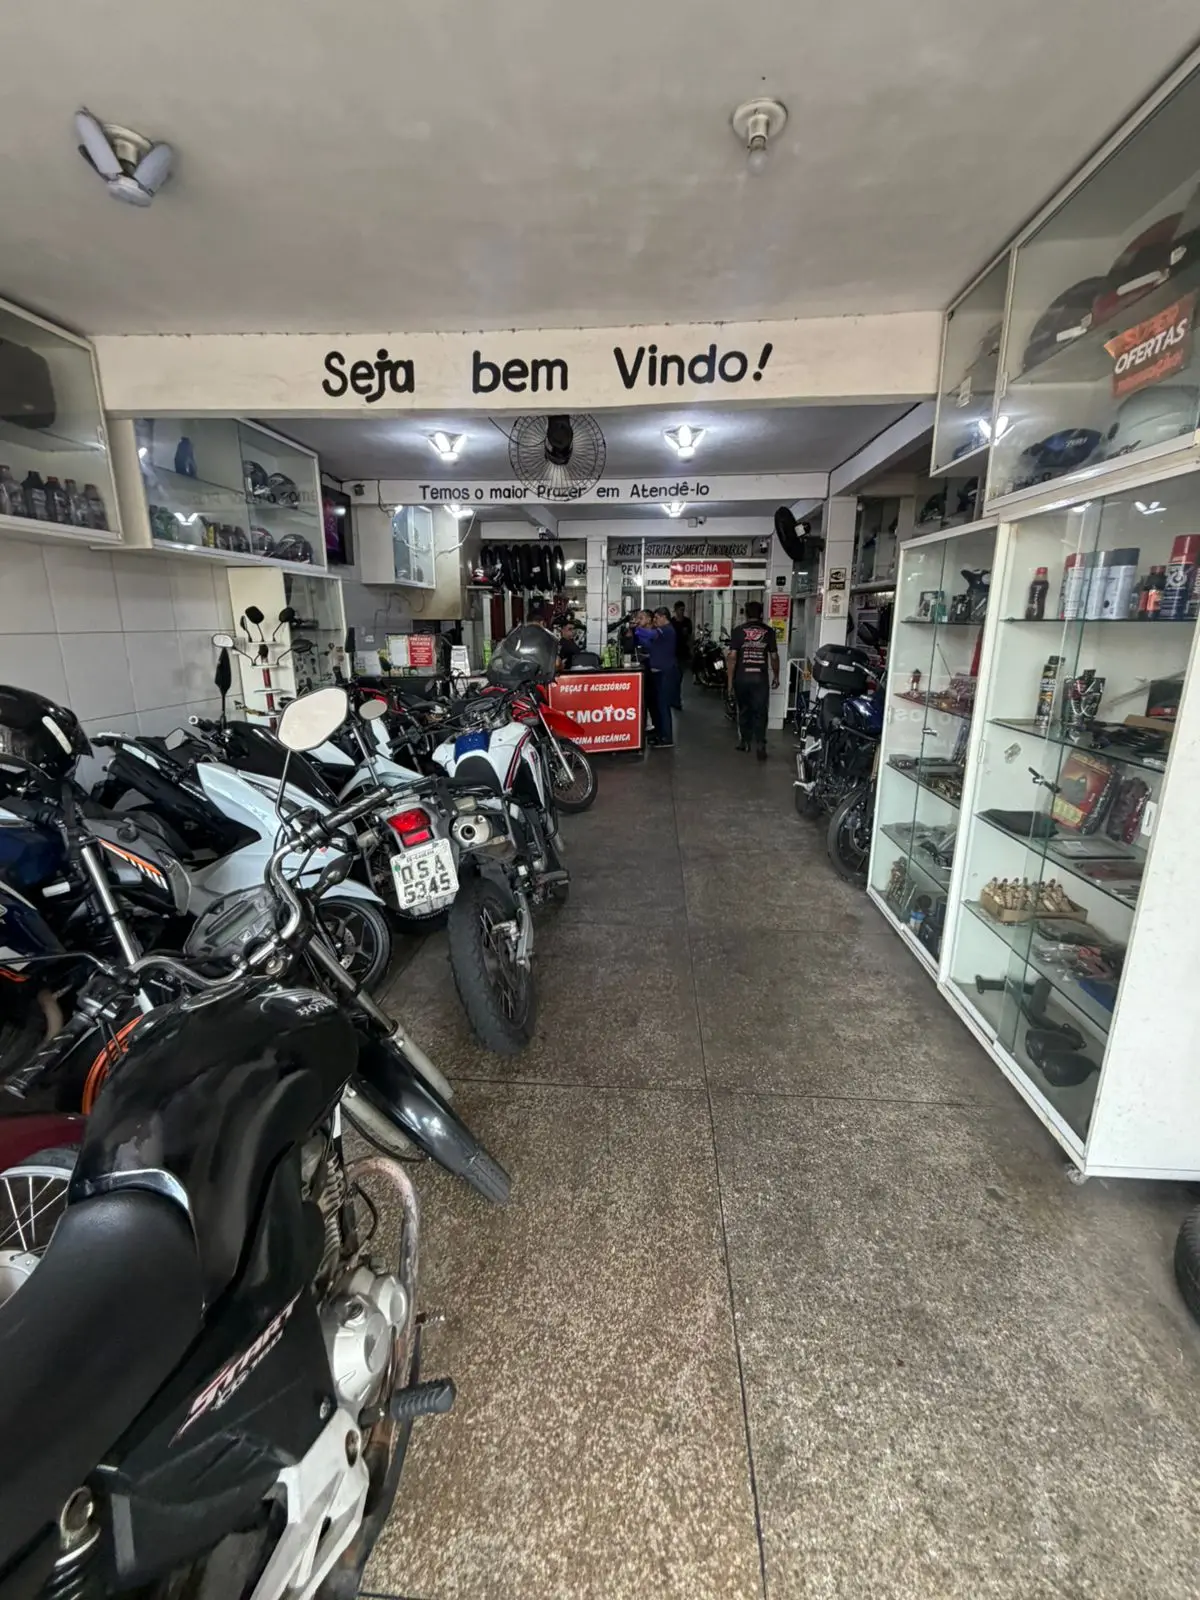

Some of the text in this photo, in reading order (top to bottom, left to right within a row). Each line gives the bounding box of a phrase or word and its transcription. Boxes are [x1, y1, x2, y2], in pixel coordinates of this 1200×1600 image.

[1114, 317, 1188, 374] OFERTAS
[322, 343, 773, 403] Seja bem Vindo!
[419, 482, 710, 500] Temos o maior Prazer em Atendê-lo
[684, 564, 719, 573] OFICINA
[560, 681, 631, 694] PEÇAS E ACESSÓRIOS
[594, 733, 631, 745] MECÂNICA
